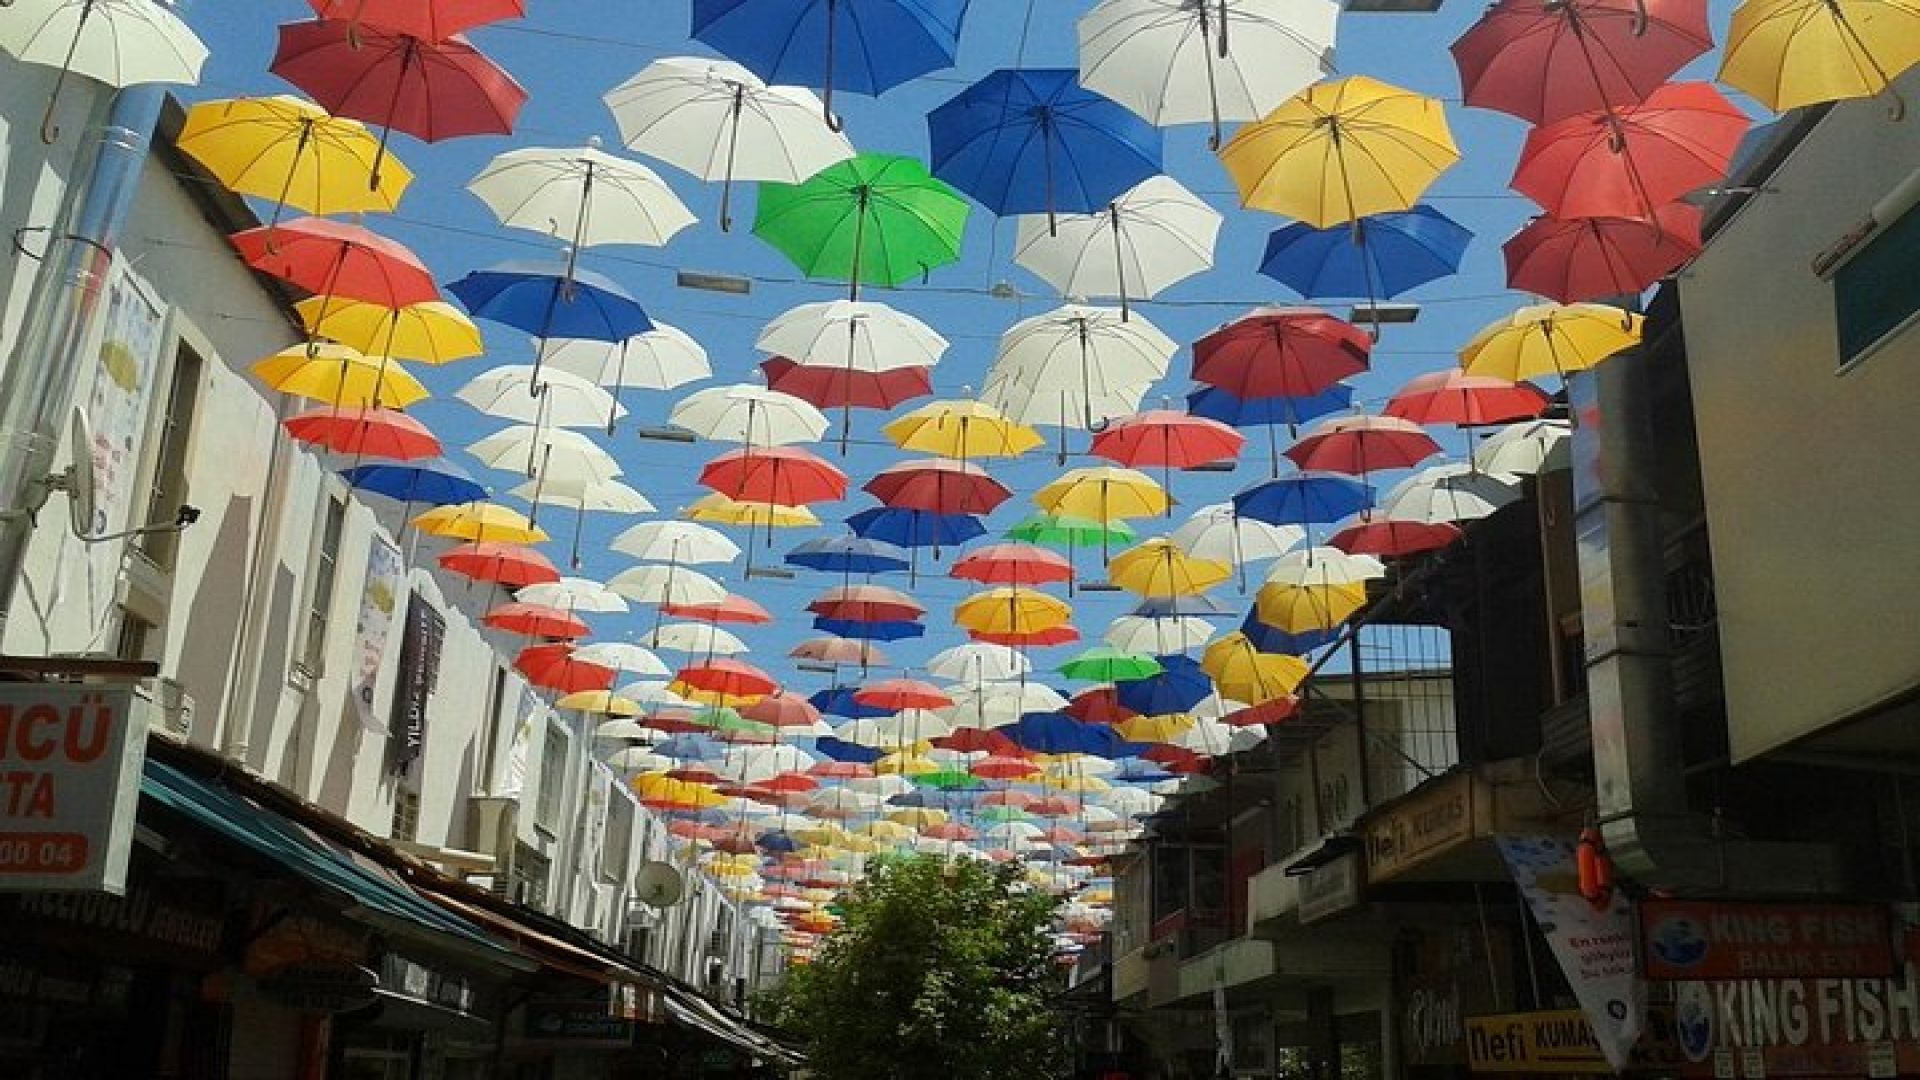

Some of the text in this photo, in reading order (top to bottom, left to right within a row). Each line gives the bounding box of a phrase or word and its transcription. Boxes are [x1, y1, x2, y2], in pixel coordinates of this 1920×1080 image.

[0, 771, 55, 817] TA
[39, 840, 73, 865] 04
[1711, 911, 1882, 944] KING FISH
[1714, 972, 1920, 1046] KING FISH
